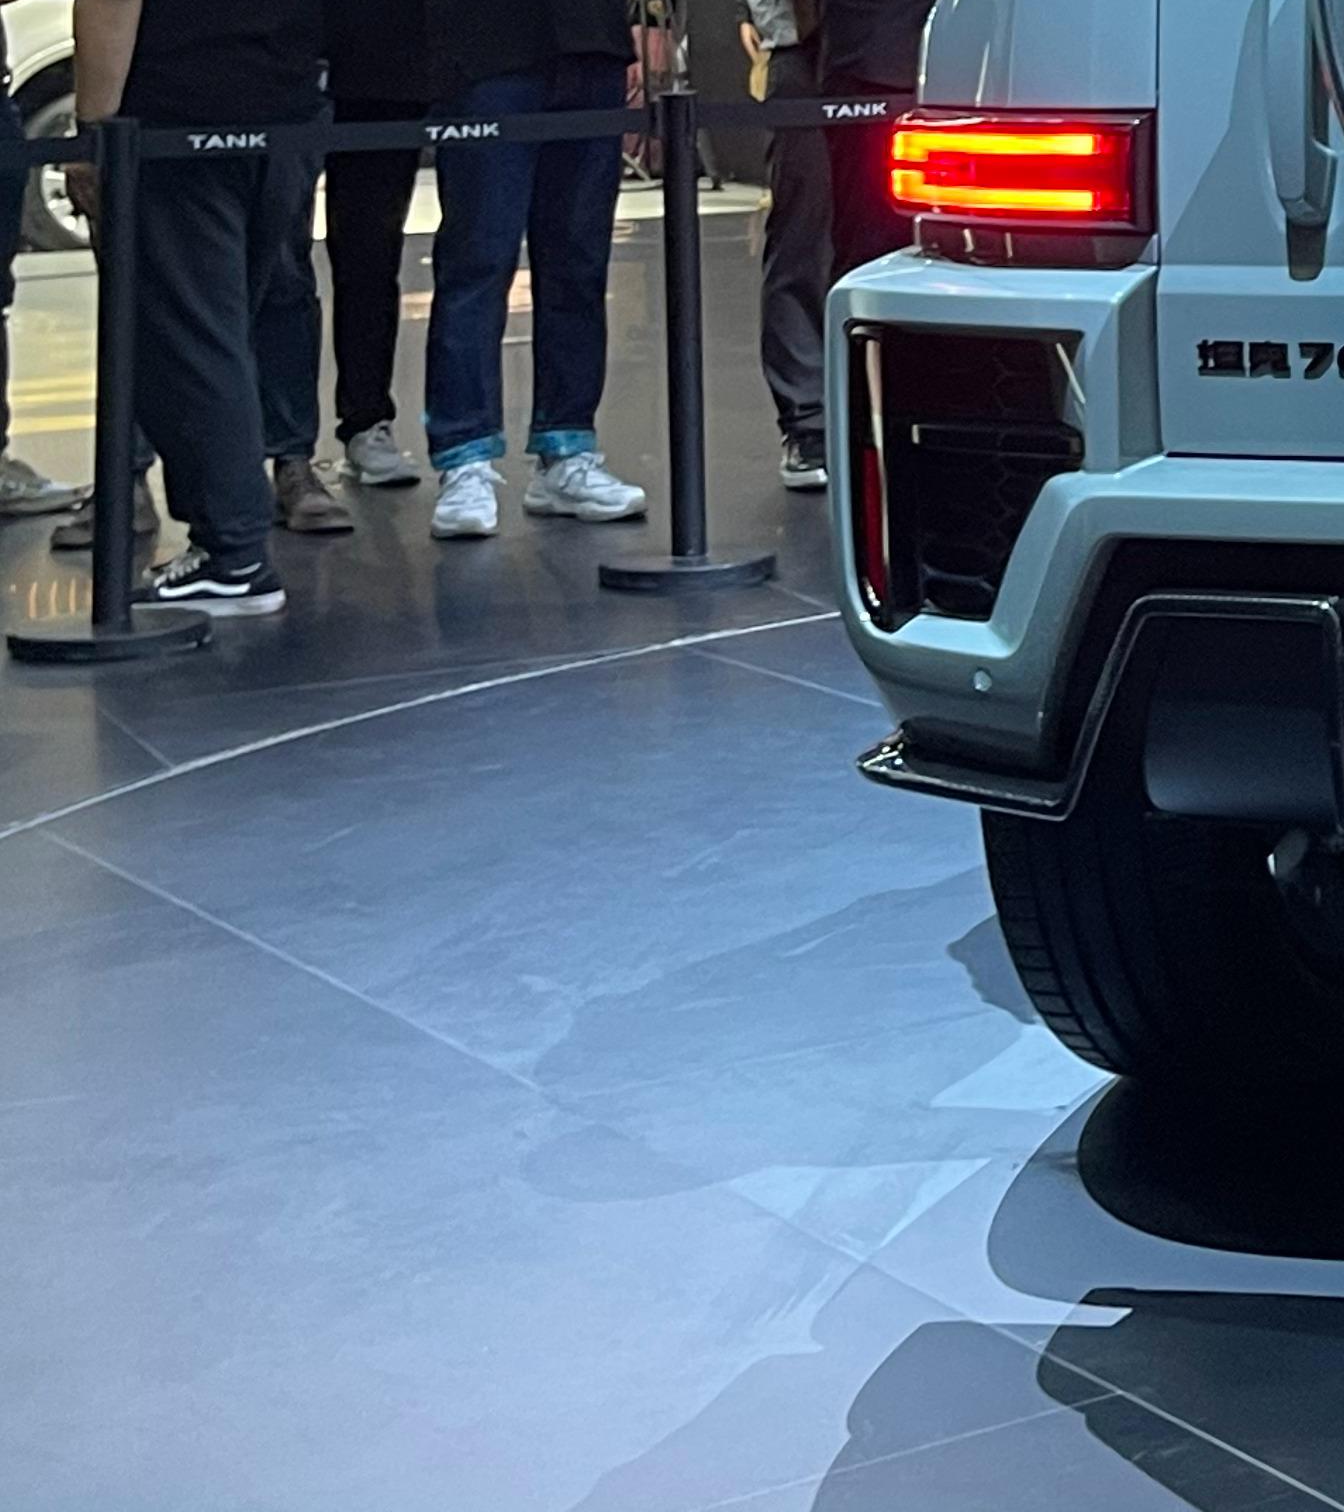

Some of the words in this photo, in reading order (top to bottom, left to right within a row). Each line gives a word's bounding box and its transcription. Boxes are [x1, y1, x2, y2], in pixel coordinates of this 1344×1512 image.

[822, 102, 887, 119] TANK
[425, 122, 499, 141] TANK
[187, 132, 267, 151] TANK
